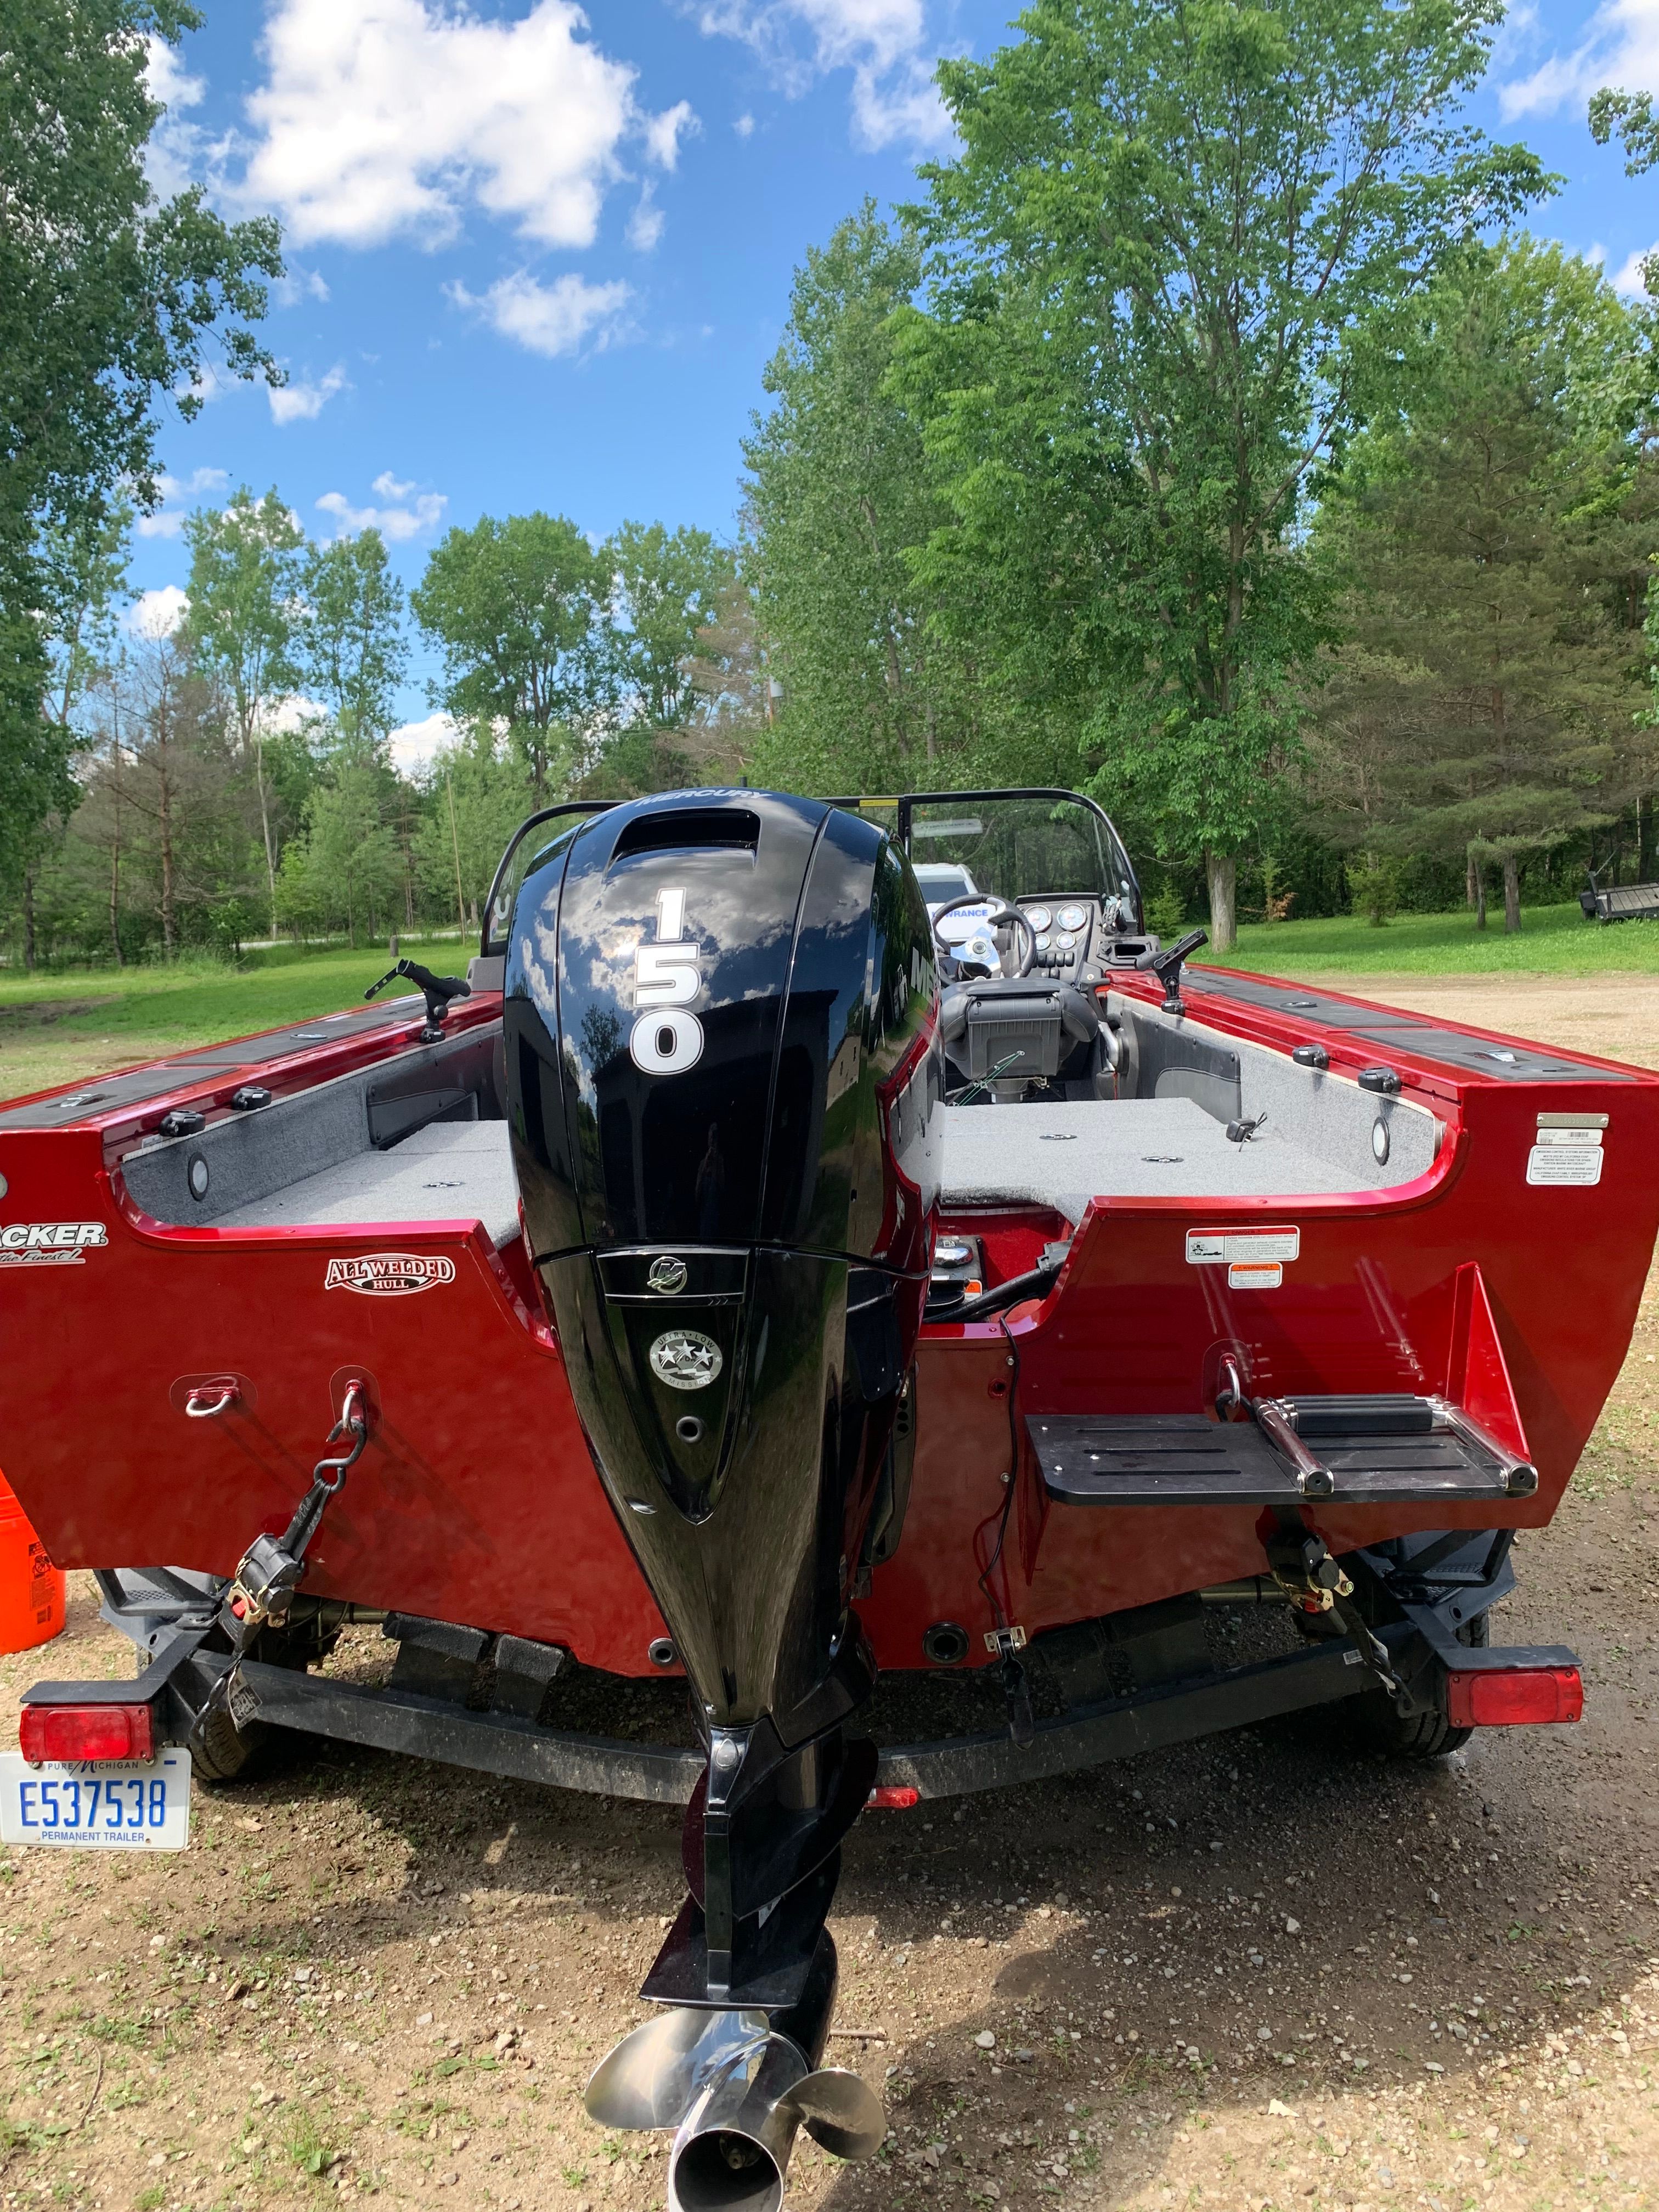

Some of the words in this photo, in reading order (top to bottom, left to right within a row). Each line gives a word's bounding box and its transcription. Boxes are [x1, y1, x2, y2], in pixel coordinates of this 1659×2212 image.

[634, 789, 773, 808] MERCURY
[630, 887, 704, 1075] 150
[328, 1261, 368, 1286] ALL
[368, 1259, 453, 1280] WELDED
[373, 1279, 409, 1290] HULL
[657, 1331, 686, 1345] ULTRA
[694, 1334, 715, 1348] LOW
[663, 1374, 712, 1387] EMISSION
[48, 1762, 74, 1770] PURE
[77, 1760, 139, 1774] MICHIGAN
[20, 1779, 166, 1827] E537538
[42, 1831, 101, 1841] PERMANENT
[103, 1832, 144, 1842] TRAILER
